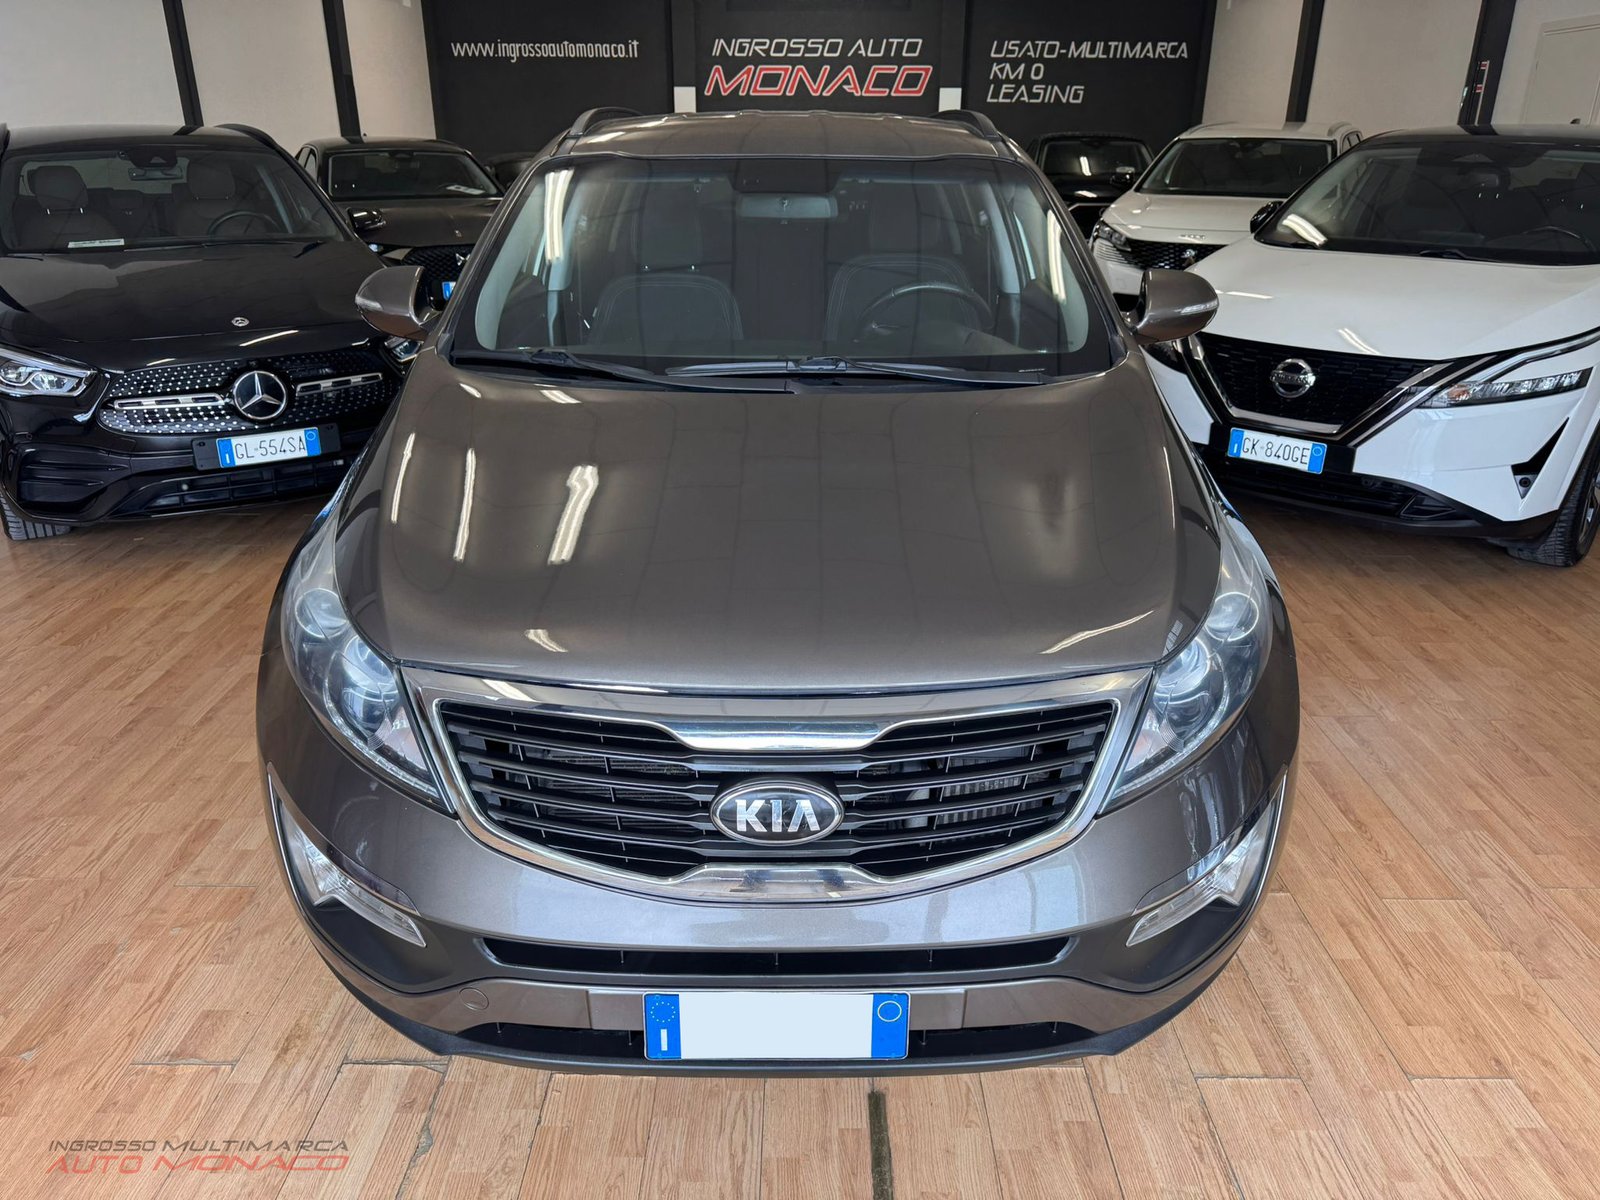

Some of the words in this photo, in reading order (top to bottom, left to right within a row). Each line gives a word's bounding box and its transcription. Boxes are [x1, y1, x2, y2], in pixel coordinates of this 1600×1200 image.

[450, 39, 640, 63] www.ingrossoautomonaco.it
[711, 38, 843, 57] INGROSSO
[847, 38, 923, 57] AUTO
[990, 40, 1188, 59] USATO-MULTIMARCA
[704, 65, 933, 97] MONACO
[989, 62, 1025, 80] KM
[986, 84, 1085, 104] LEASING
[735, 799, 821, 833] KIA
